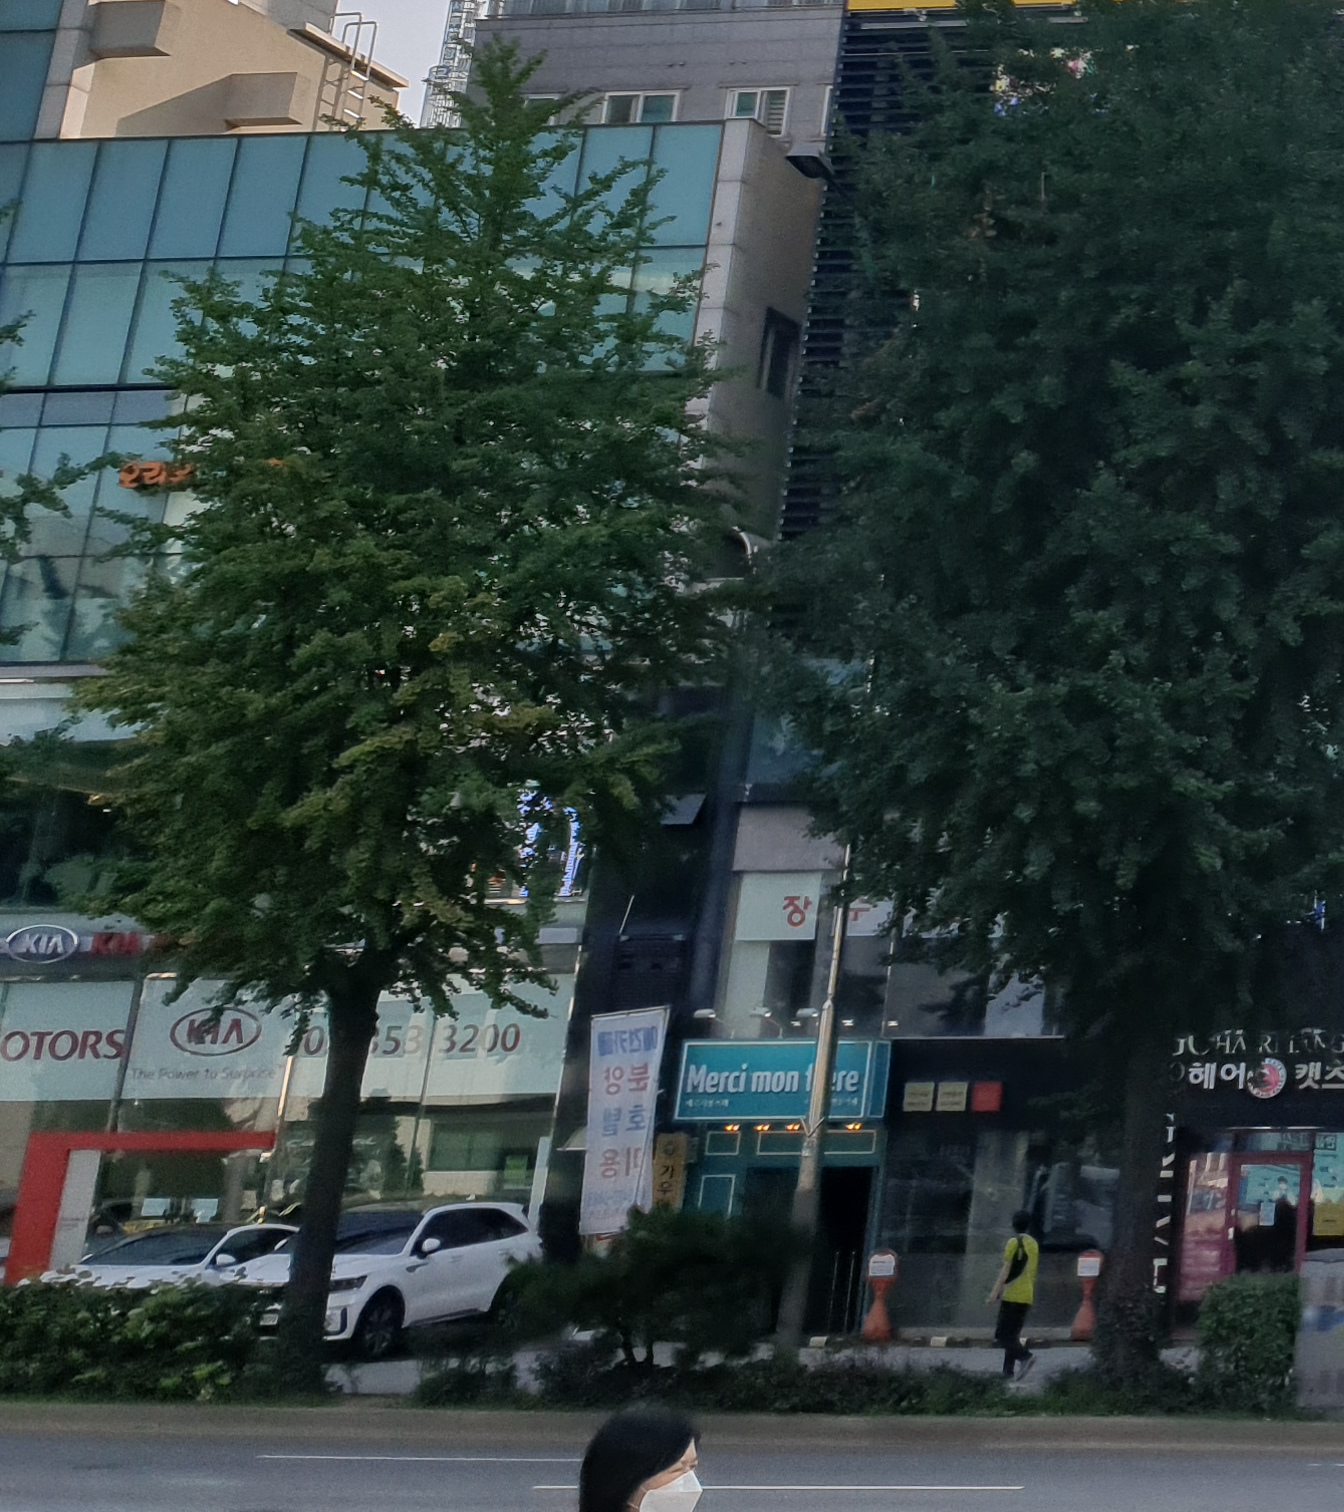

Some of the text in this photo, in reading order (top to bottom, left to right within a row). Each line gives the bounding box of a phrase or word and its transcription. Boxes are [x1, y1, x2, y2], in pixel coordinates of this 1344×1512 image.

[23, 933, 65, 954] KIA
[684, 1063, 748, 1094] Merci
[751, 1070, 800, 1093] mon
[1188, 1061, 1247, 1090] 헤어
